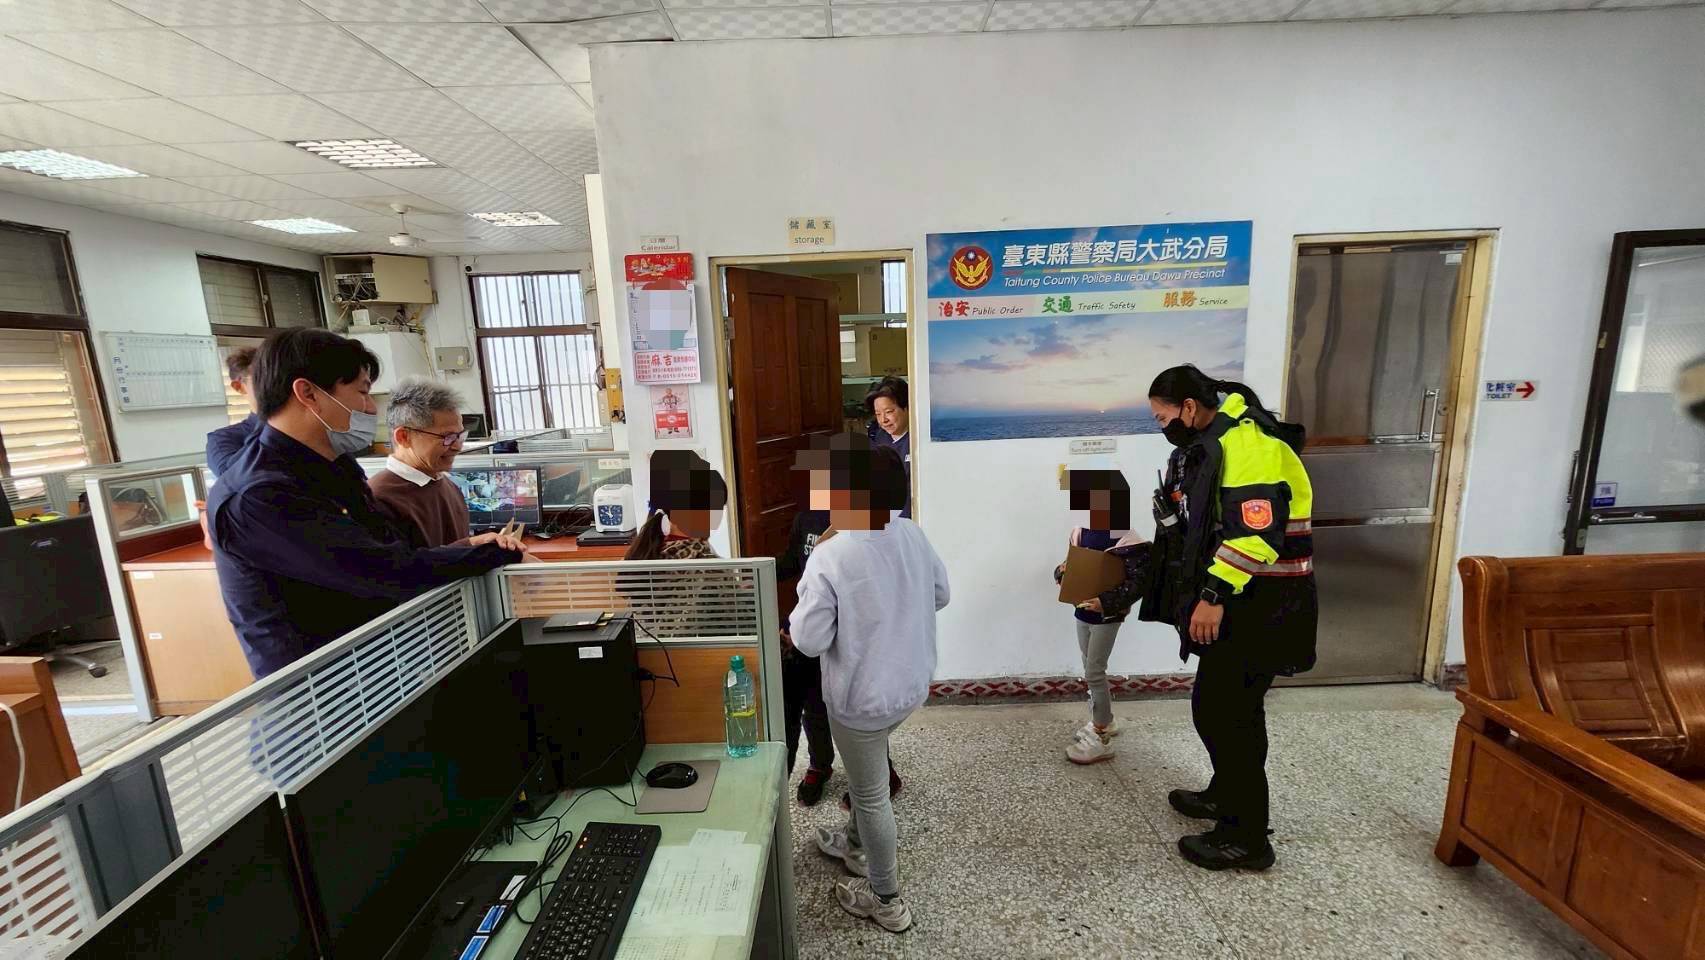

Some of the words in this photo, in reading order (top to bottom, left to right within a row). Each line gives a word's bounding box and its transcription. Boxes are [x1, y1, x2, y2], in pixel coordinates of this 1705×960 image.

[789, 219, 832, 230] 儲藏室
[794, 235, 825, 245] storage
[1001, 235, 1229, 268] 臺東縣警察局大武分局
[1004, 276, 1040, 288] Taitung
[1043, 274, 1079, 287] County
[1082, 272, 1112, 284] Police
[1114, 271, 1150, 282] Bureau
[1152, 270, 1182, 280] Dawu
[1184, 268, 1226, 279] Precinct
[1041, 295, 1074, 314] 交通
[1163, 290, 1198, 308] 服務
[1199, 297, 1228, 307] Service
[938, 300, 970, 318] 治安
[972, 305, 996, 316] Public
[1000, 305, 1024, 315] Order
[1077, 301, 1105, 311] Traffic
[1108, 301, 1136, 312] Safety
